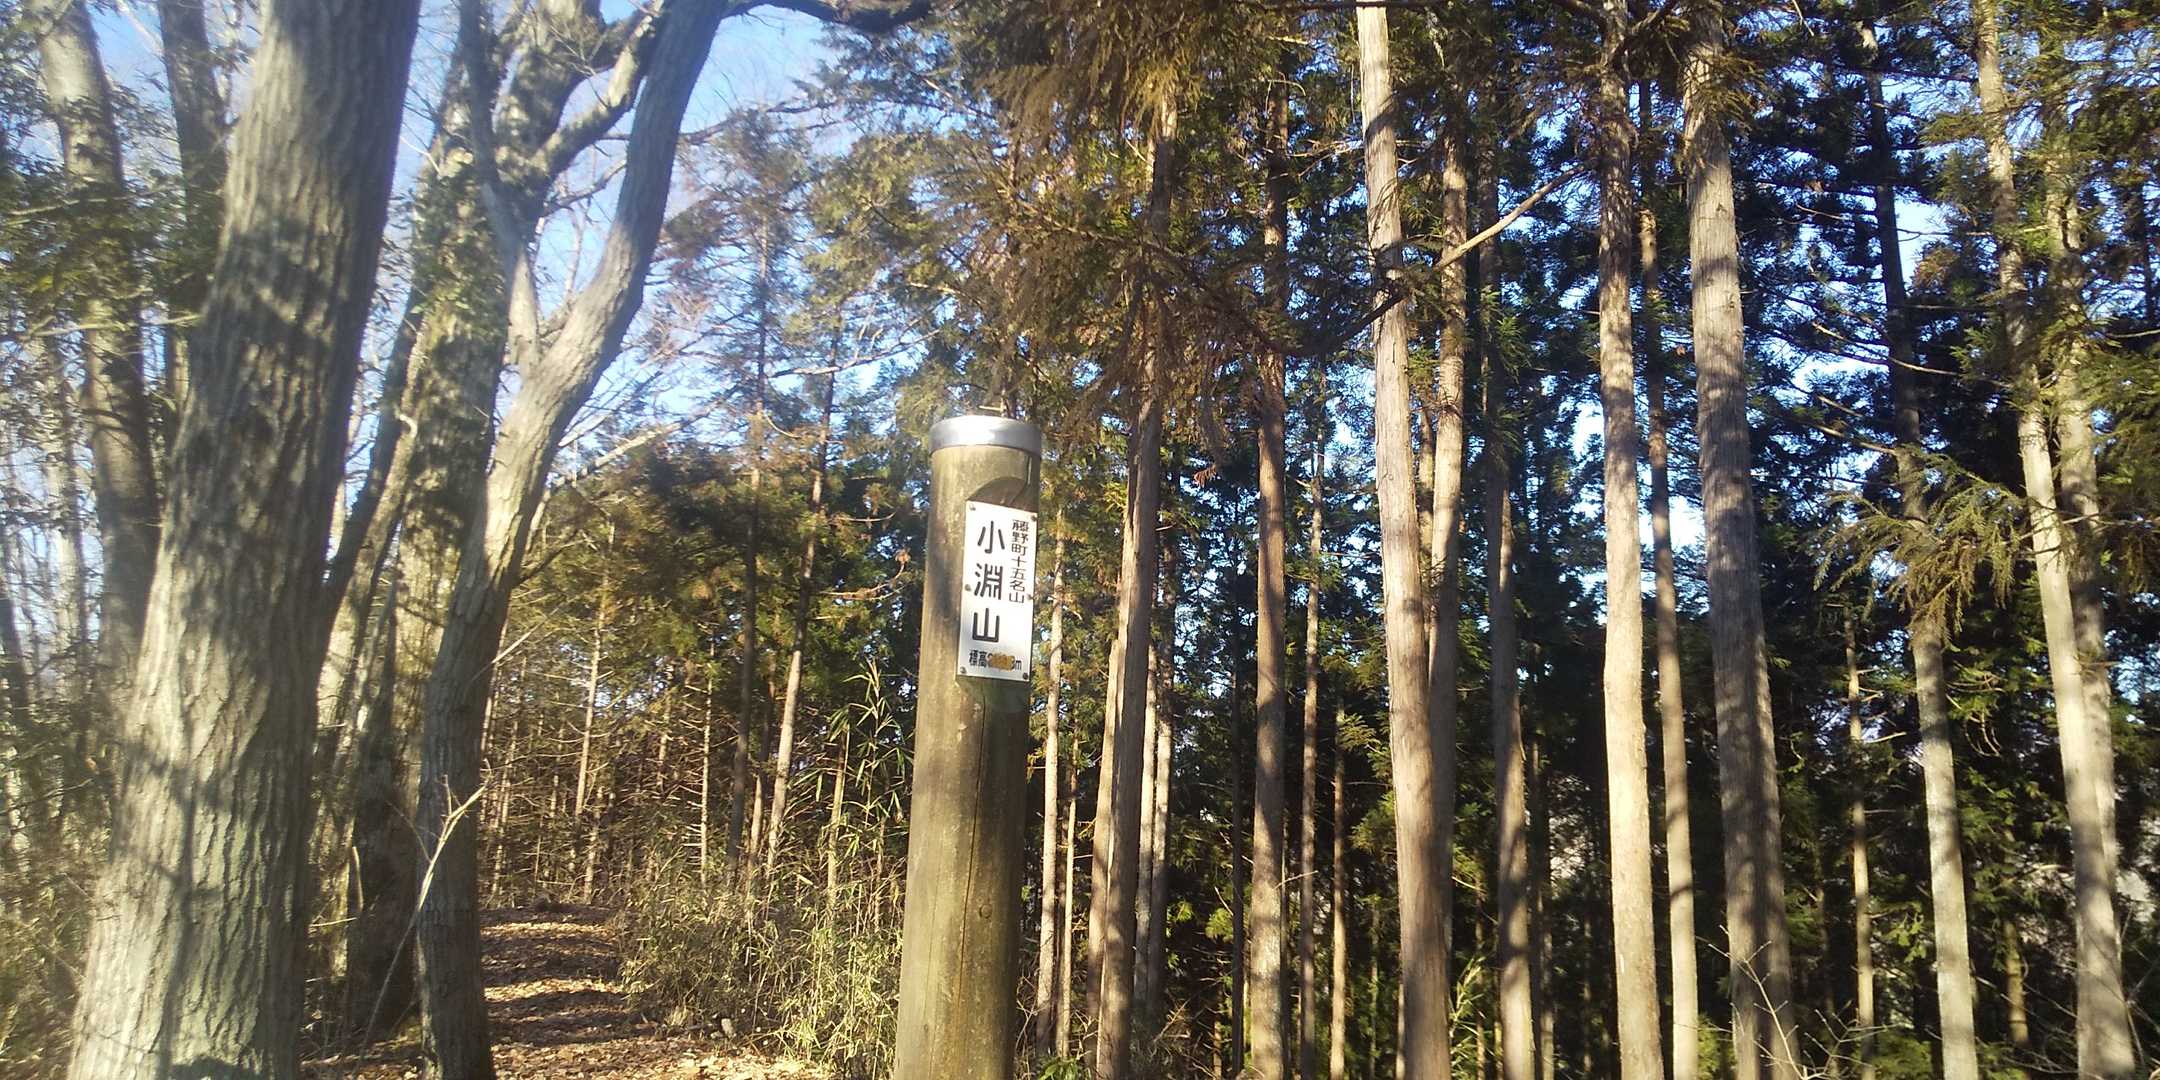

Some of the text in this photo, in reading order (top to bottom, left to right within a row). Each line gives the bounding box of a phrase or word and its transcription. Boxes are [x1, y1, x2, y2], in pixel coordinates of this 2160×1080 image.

[972, 520, 1005, 643] 小淵山
[1008, 519, 1029, 604] 藤野町十五名山
